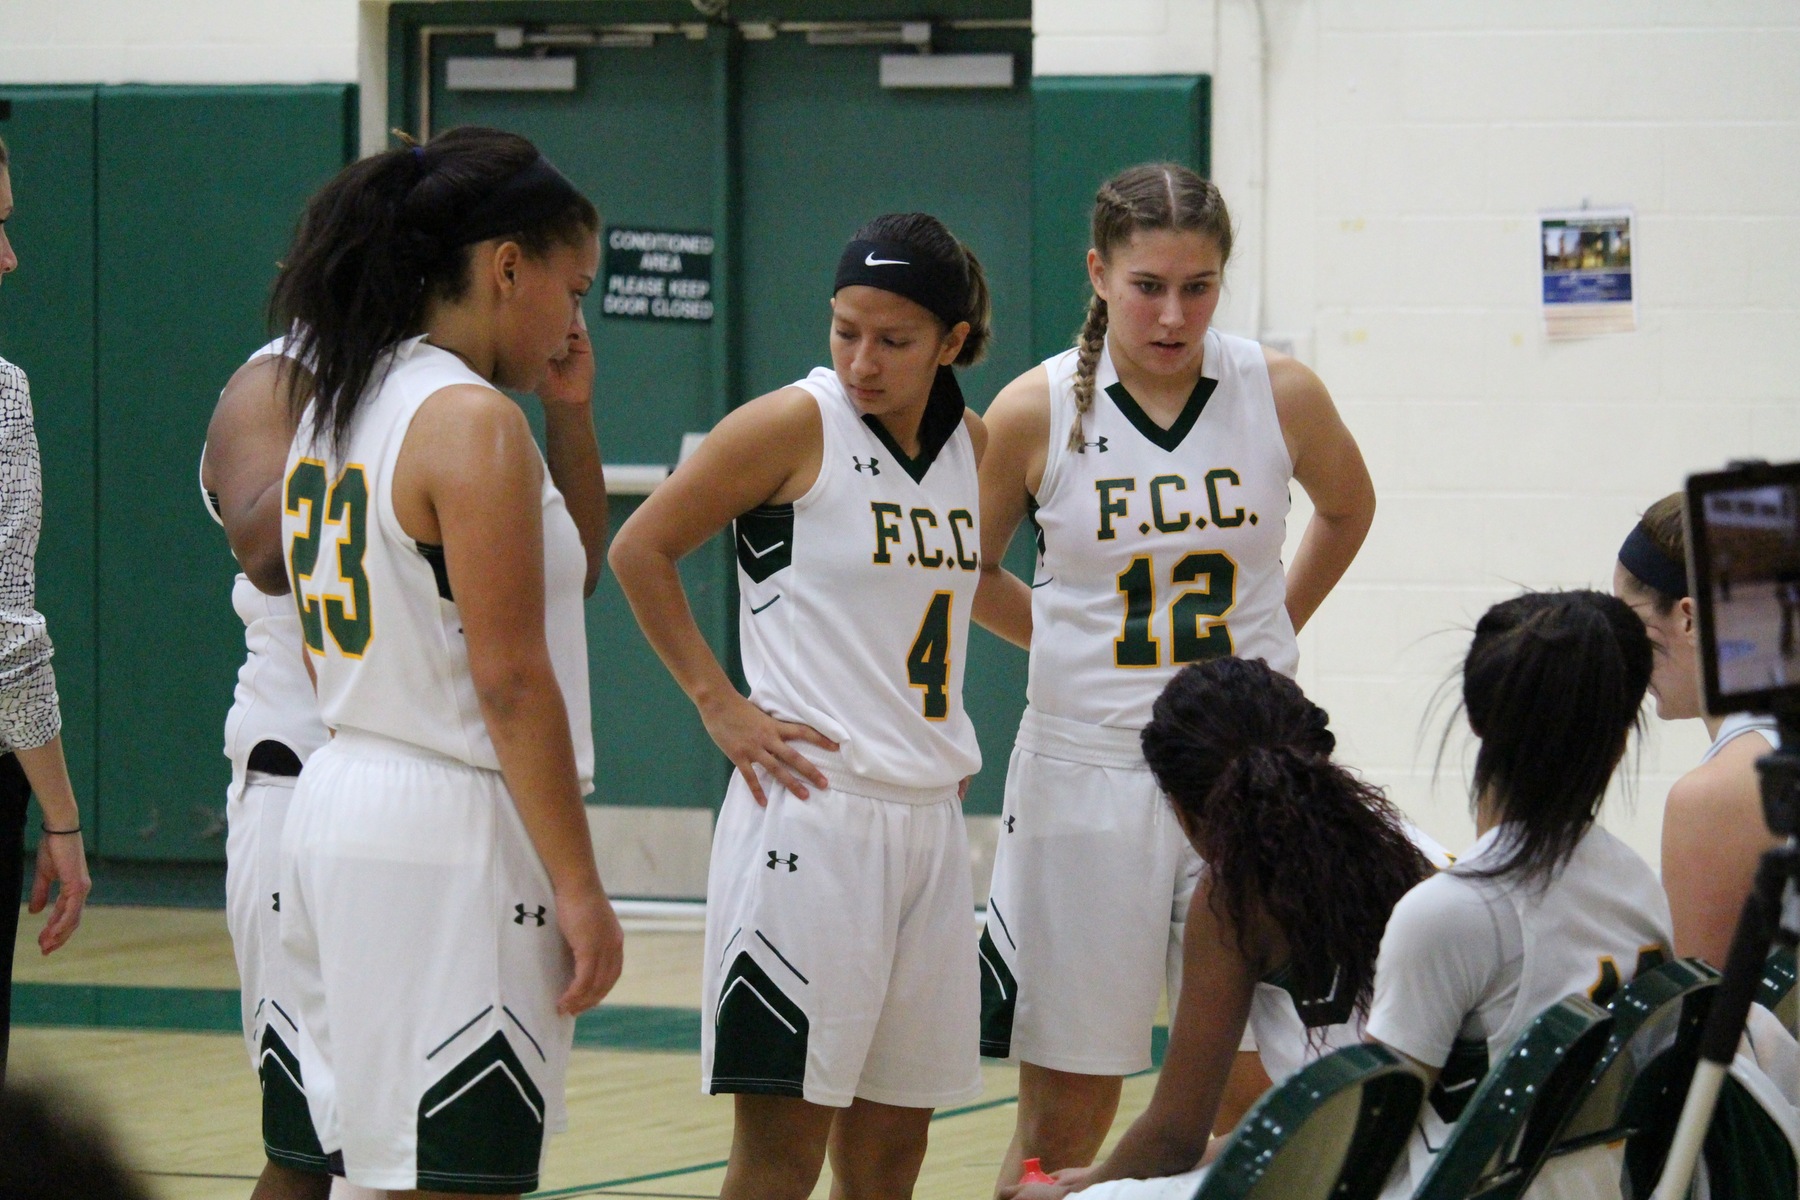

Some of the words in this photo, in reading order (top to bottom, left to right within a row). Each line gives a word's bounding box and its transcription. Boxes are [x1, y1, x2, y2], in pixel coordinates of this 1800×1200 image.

[609, 230, 714, 254] CONDITIONED
[640, 252, 682, 272] AREA
[604, 294, 648, 315] DOOR
[651, 297, 714, 320] CLOSED
[609, 275, 665, 297] PLEASE
[669, 280, 709, 299] KEEP
[1094, 468, 1259, 542] F.C.C.
[285, 457, 375, 660] 23
[1113, 550, 1239, 668] 12
[906, 589, 954, 722] 4
